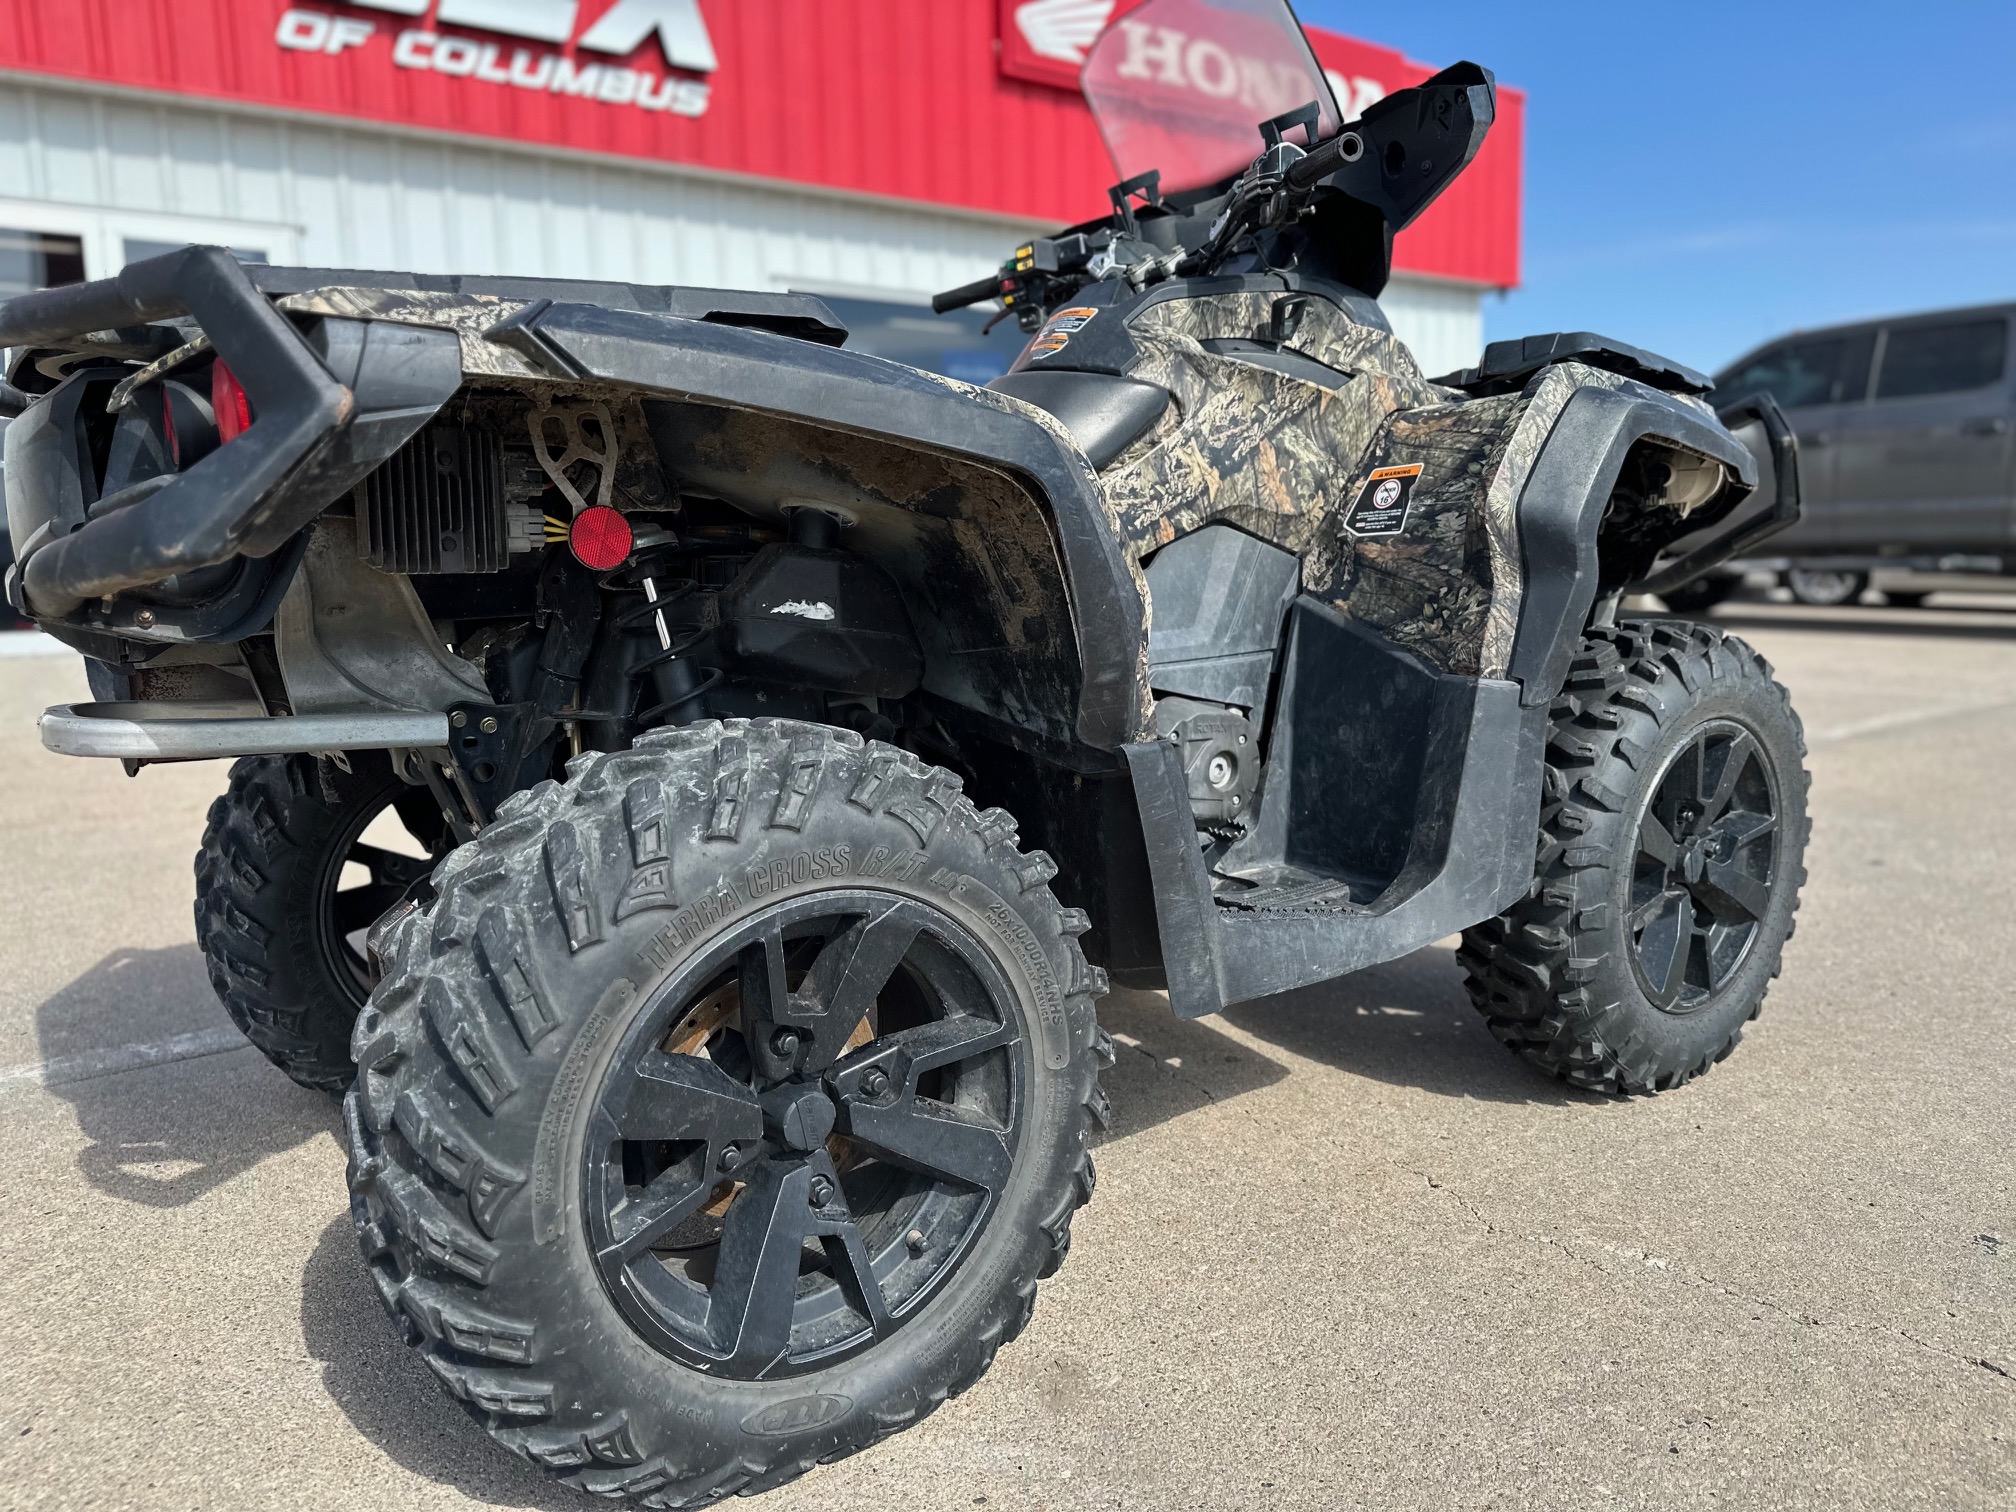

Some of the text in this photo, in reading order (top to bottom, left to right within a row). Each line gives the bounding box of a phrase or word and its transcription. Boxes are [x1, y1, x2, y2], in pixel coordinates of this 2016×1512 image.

[276, 9, 375, 54] OF
[393, 29, 709, 117] COLUMBUS
[638, 880, 742, 971] TERRA
[746, 844, 850, 899] CROSS
[858, 846, 930, 882] R/T
[985, 913, 1002, 929] NOT
[1000, 929, 1015, 945] FOR
[1033, 985, 1050, 1022] SERVICE
[541, 1109, 554, 1132] PLY
[551, 1012, 600, 1102] CONSTRUCTION
